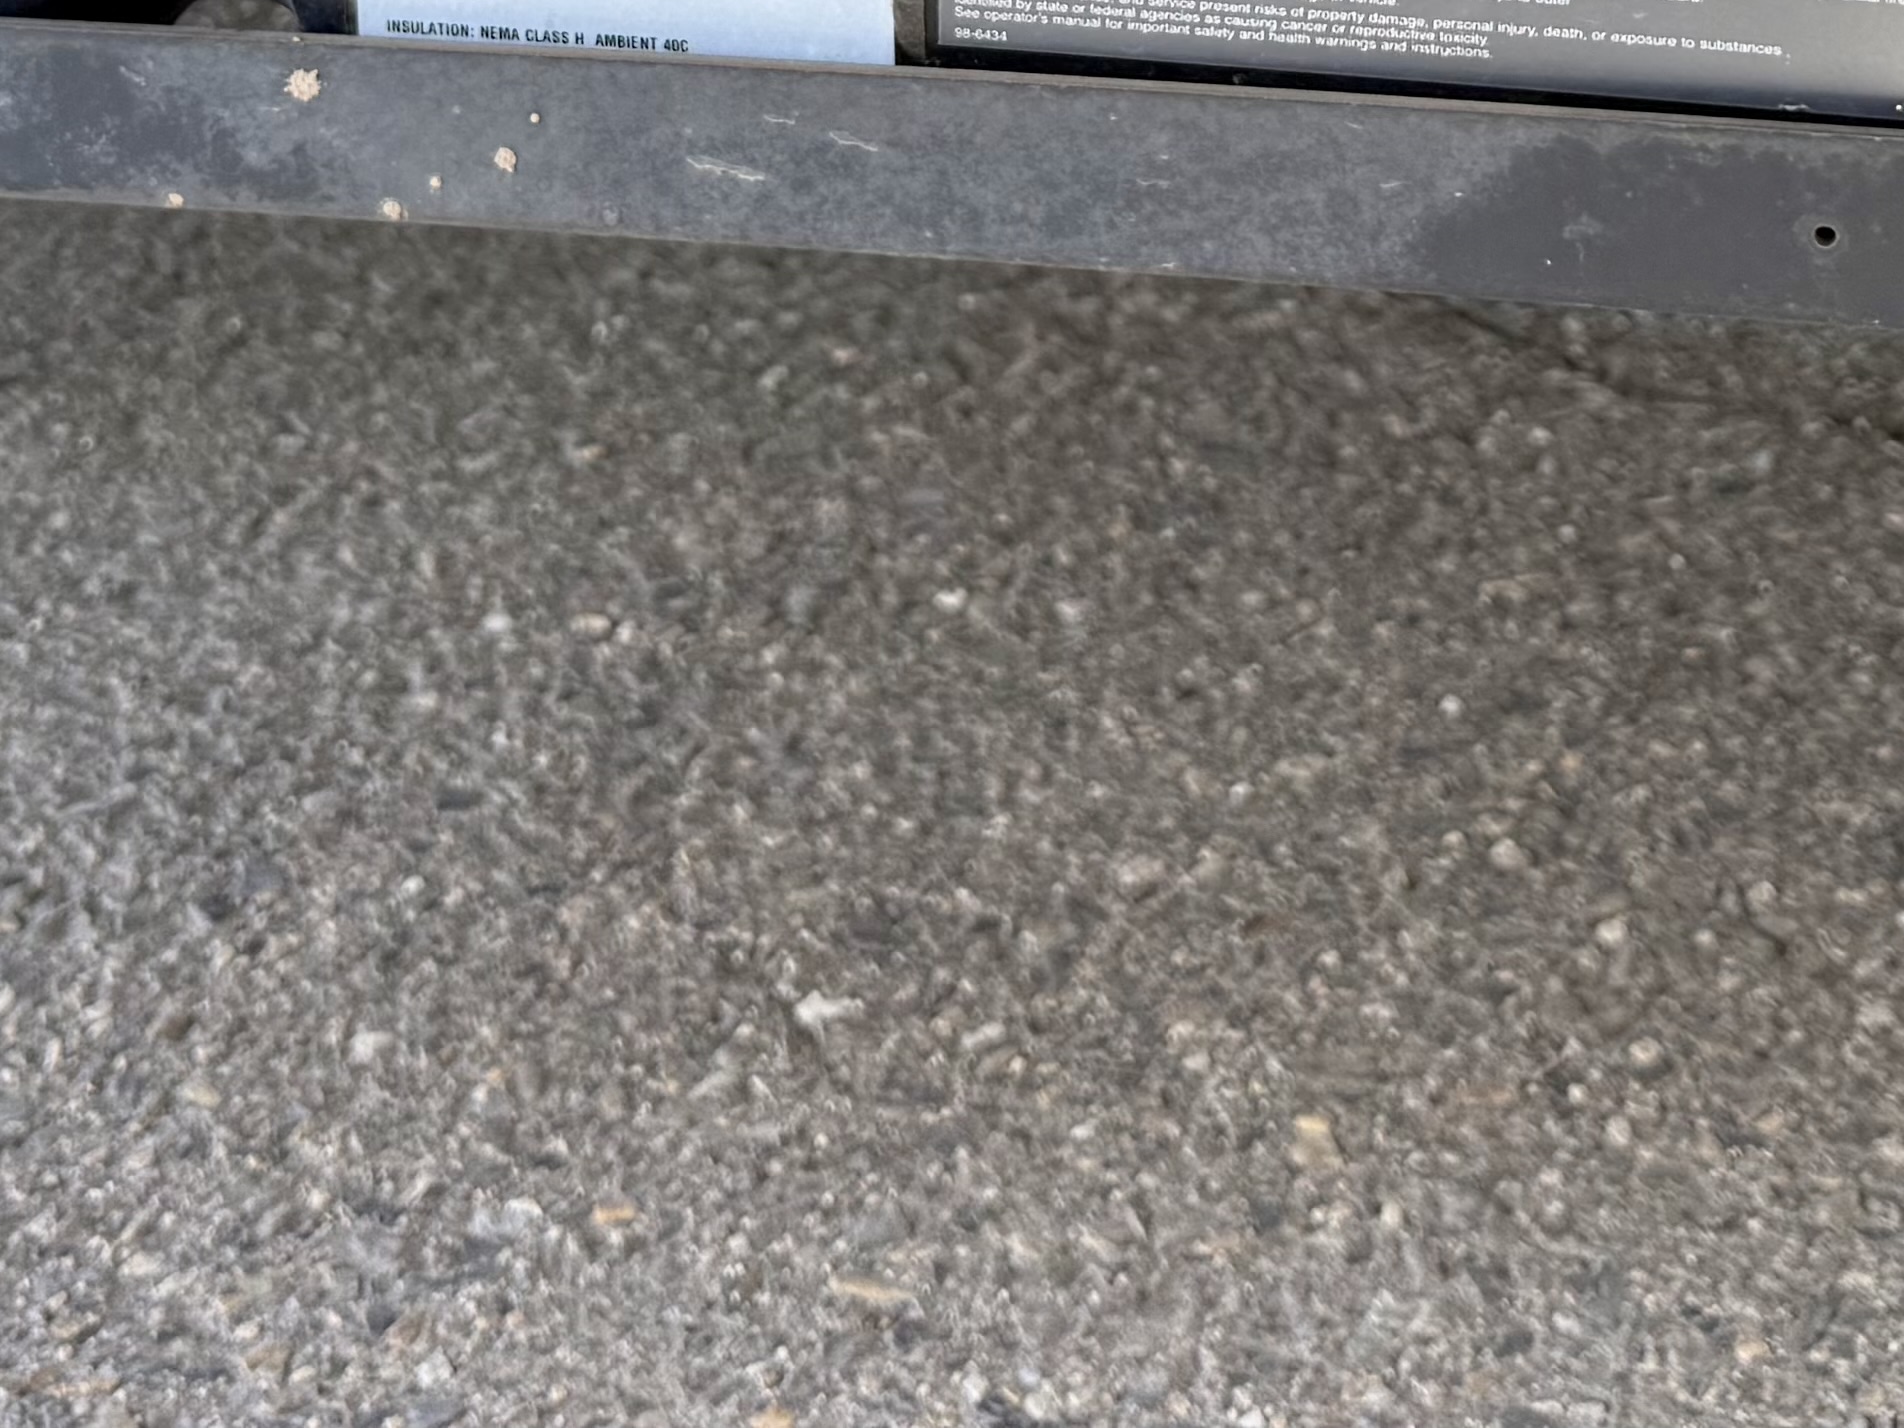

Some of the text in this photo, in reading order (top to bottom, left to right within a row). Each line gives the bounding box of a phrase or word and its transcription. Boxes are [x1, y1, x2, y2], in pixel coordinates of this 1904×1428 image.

[387, 19, 688, 52] INSULATION: NEMA CLASS H AMBIENT 40C
